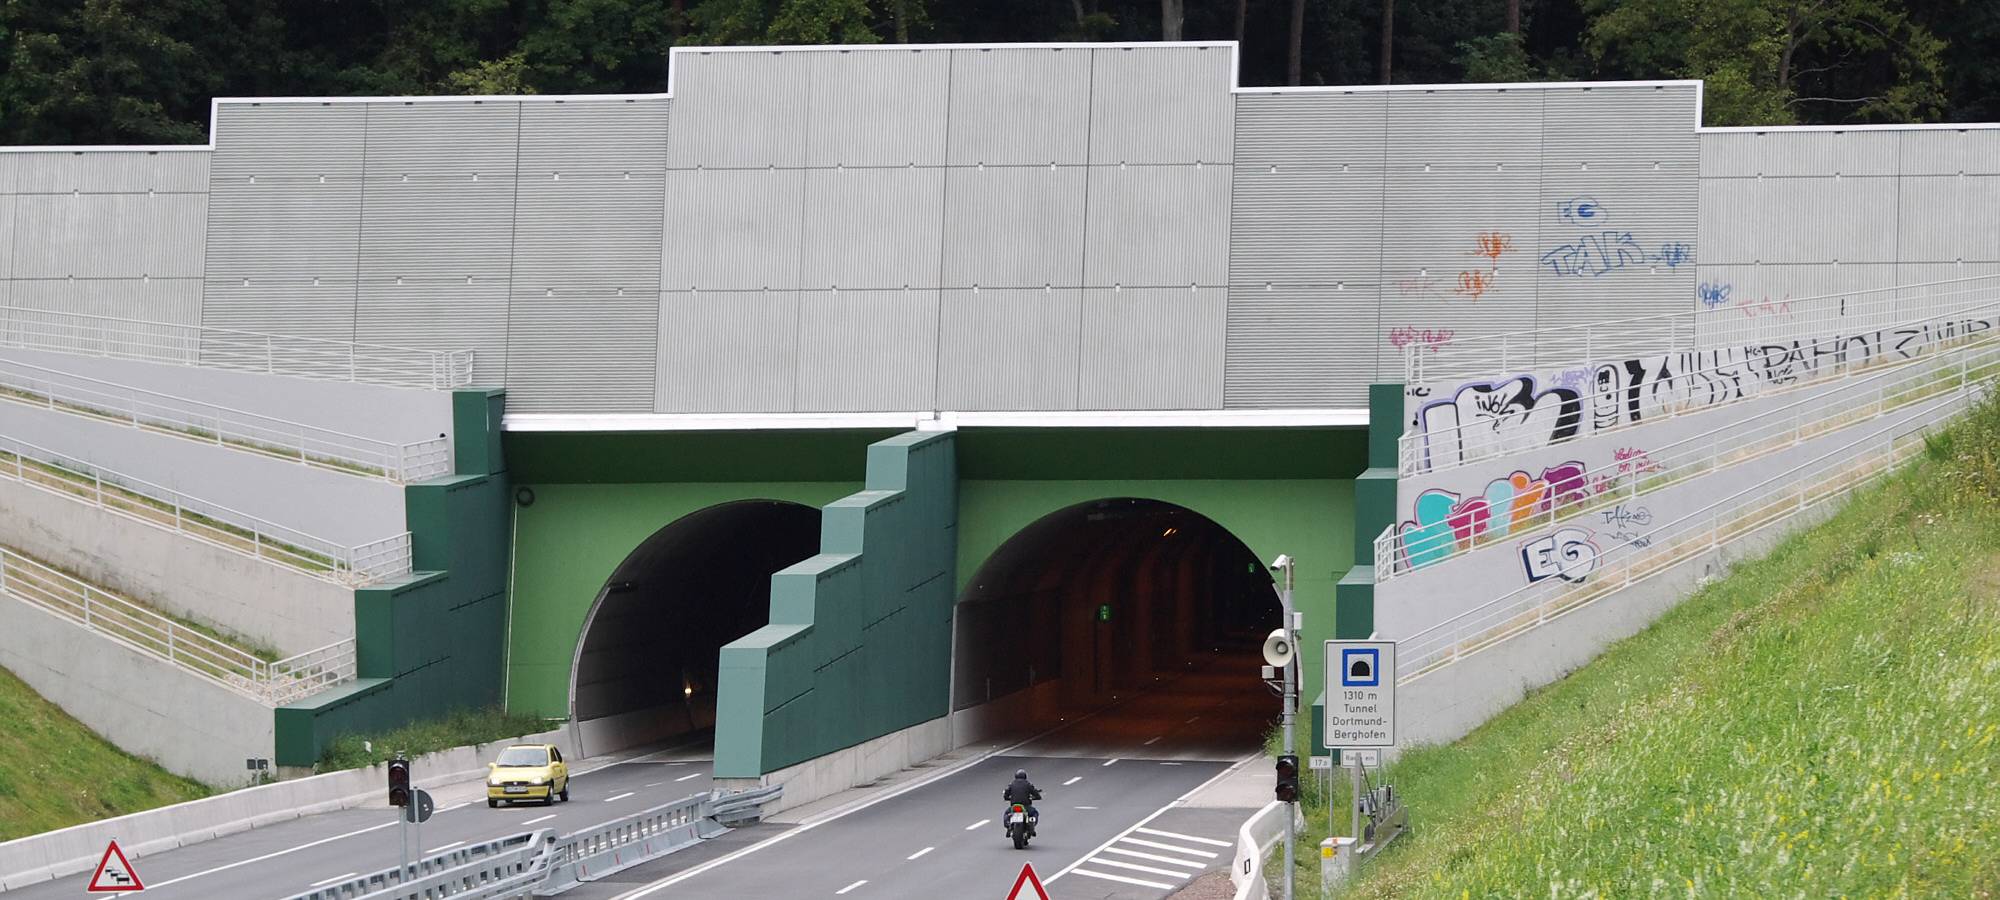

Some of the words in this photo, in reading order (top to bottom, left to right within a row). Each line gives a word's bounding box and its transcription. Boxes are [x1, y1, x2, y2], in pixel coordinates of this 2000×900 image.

[1541, 231, 1645, 277] TAK
[1344, 691, 1364, 700] 1310
[1344, 704, 1377, 713] Tunnel
[1332, 717, 1388, 726] Dortmund-
[1335, 730, 1386, 741] Berghofen
